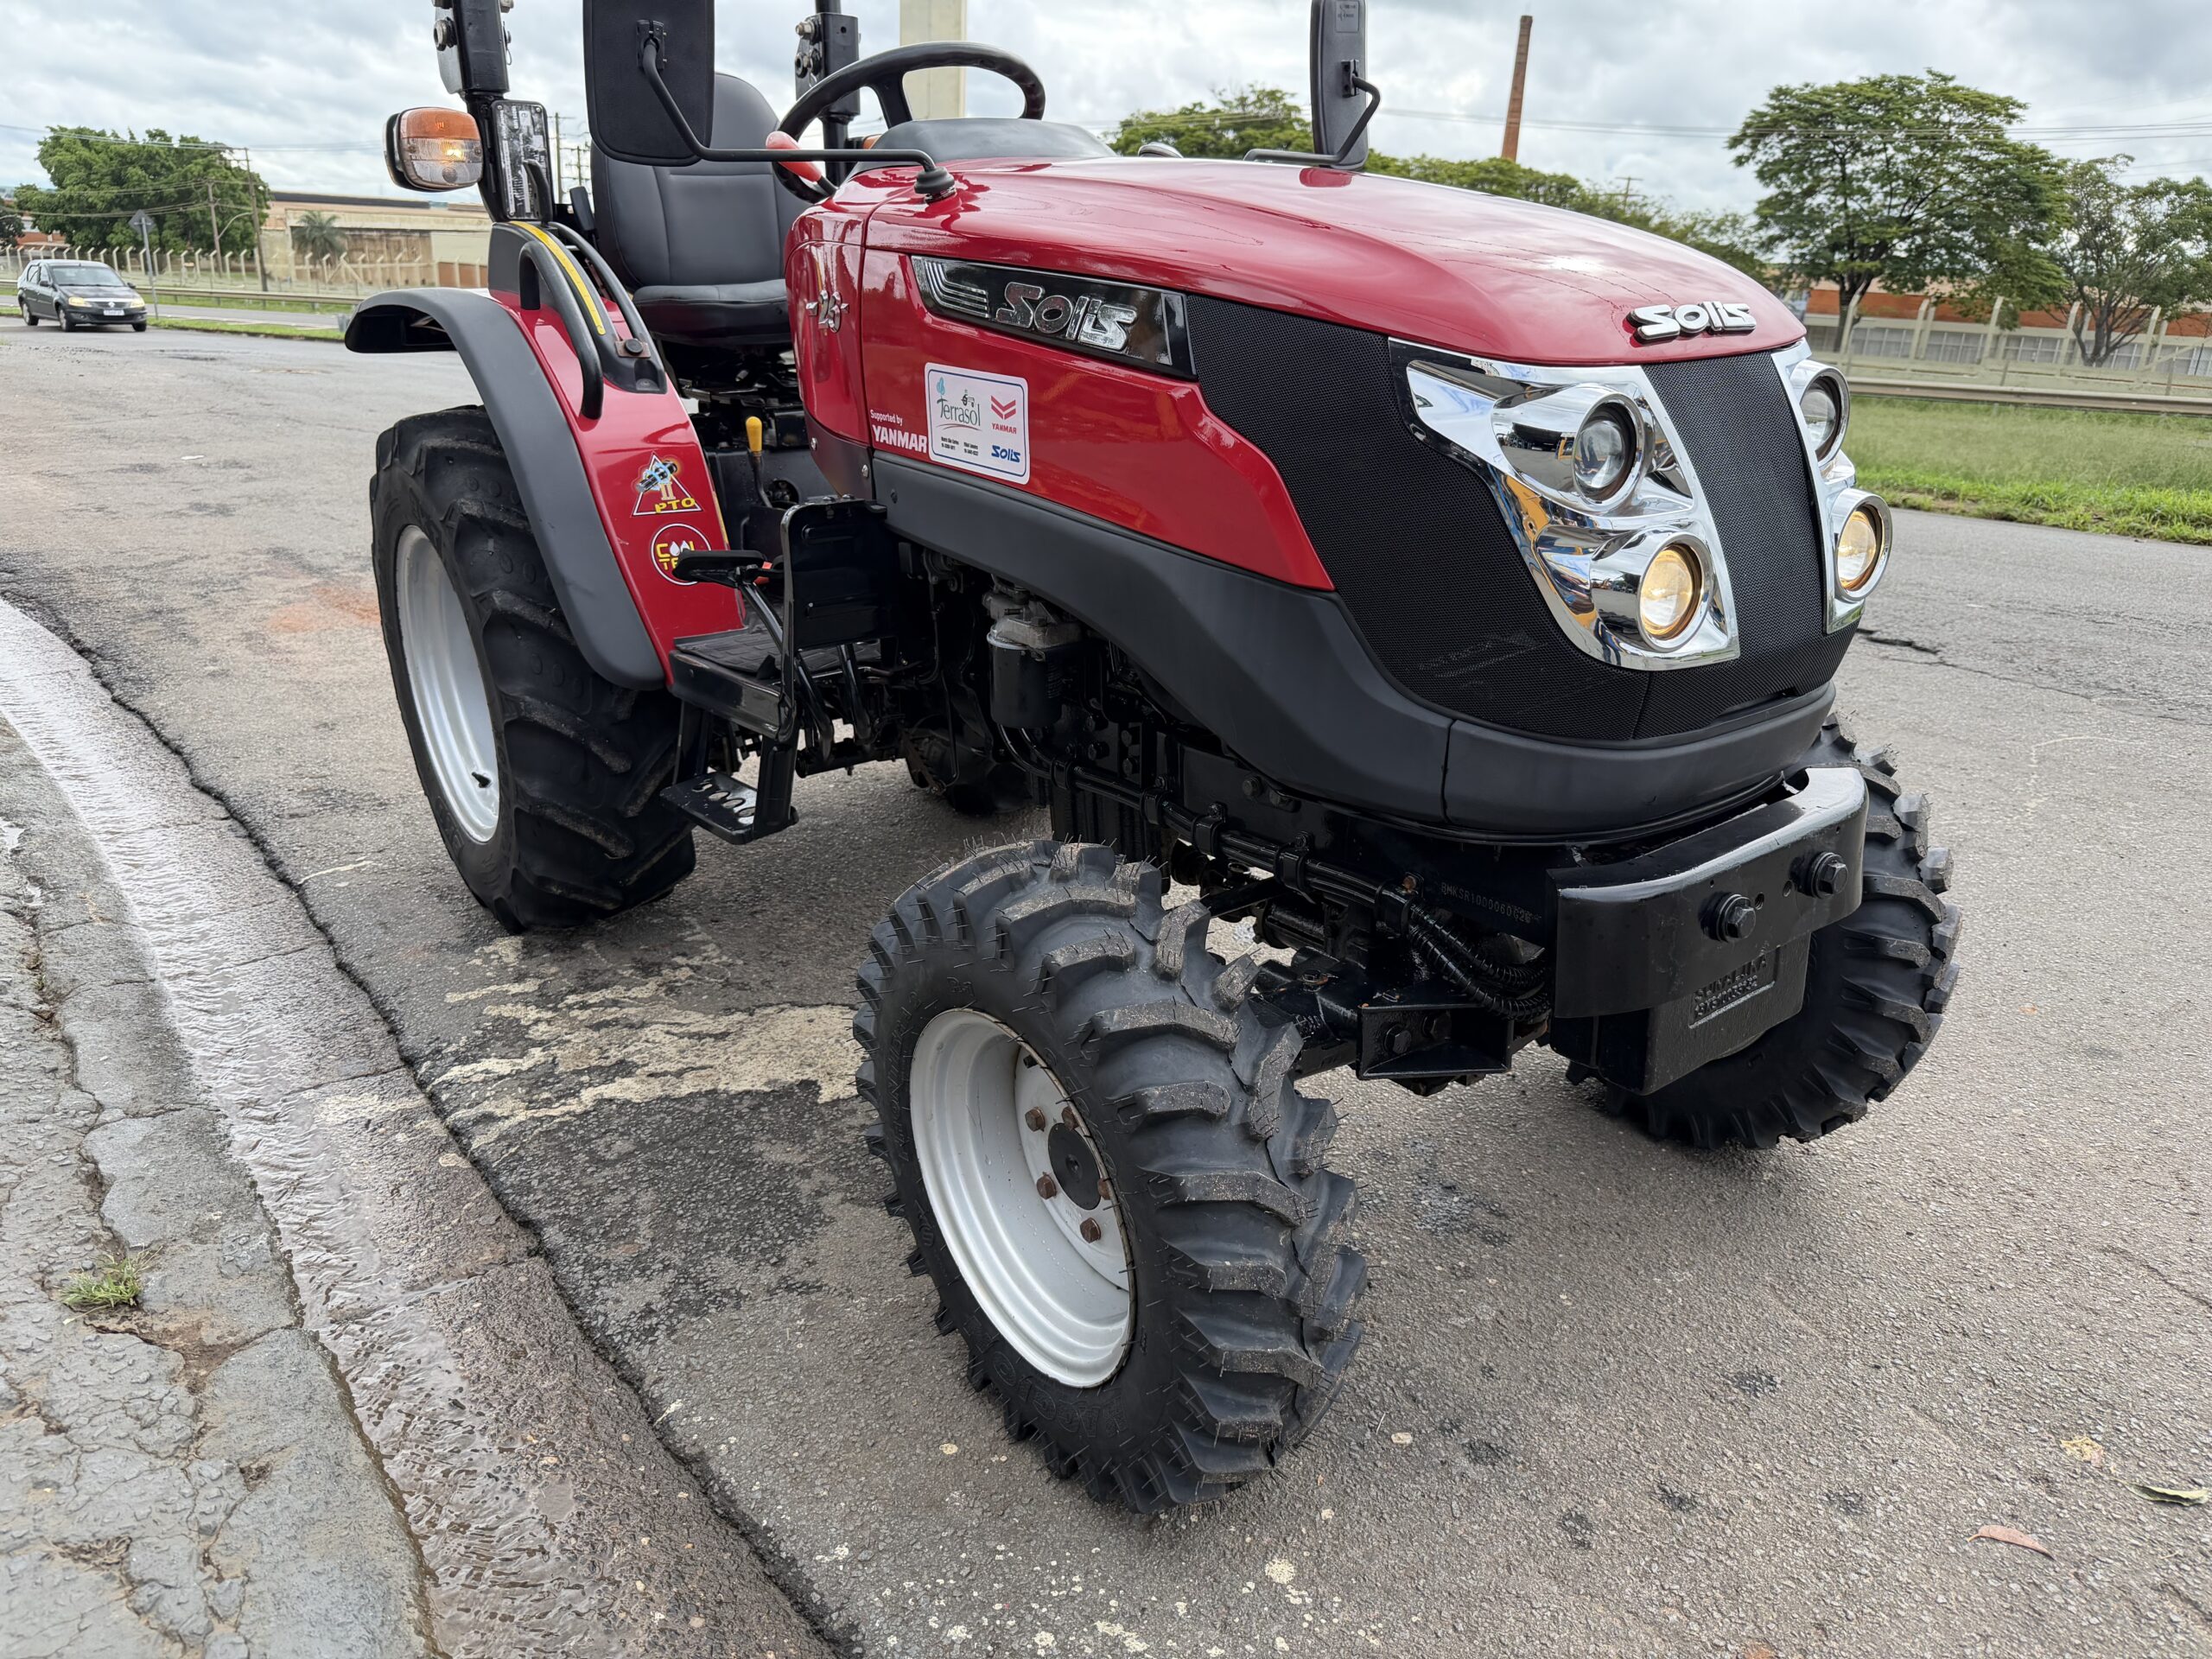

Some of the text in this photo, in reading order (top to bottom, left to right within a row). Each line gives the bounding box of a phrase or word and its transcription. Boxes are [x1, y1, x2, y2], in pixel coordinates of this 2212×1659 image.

[870, 409, 903, 426] Supported by
[936, 397, 981, 426] Terrasol
[991, 423, 1017, 435] YANMAR
[873, 424, 927, 454] YANMAR
[654, 497, 696, 513] PTO
